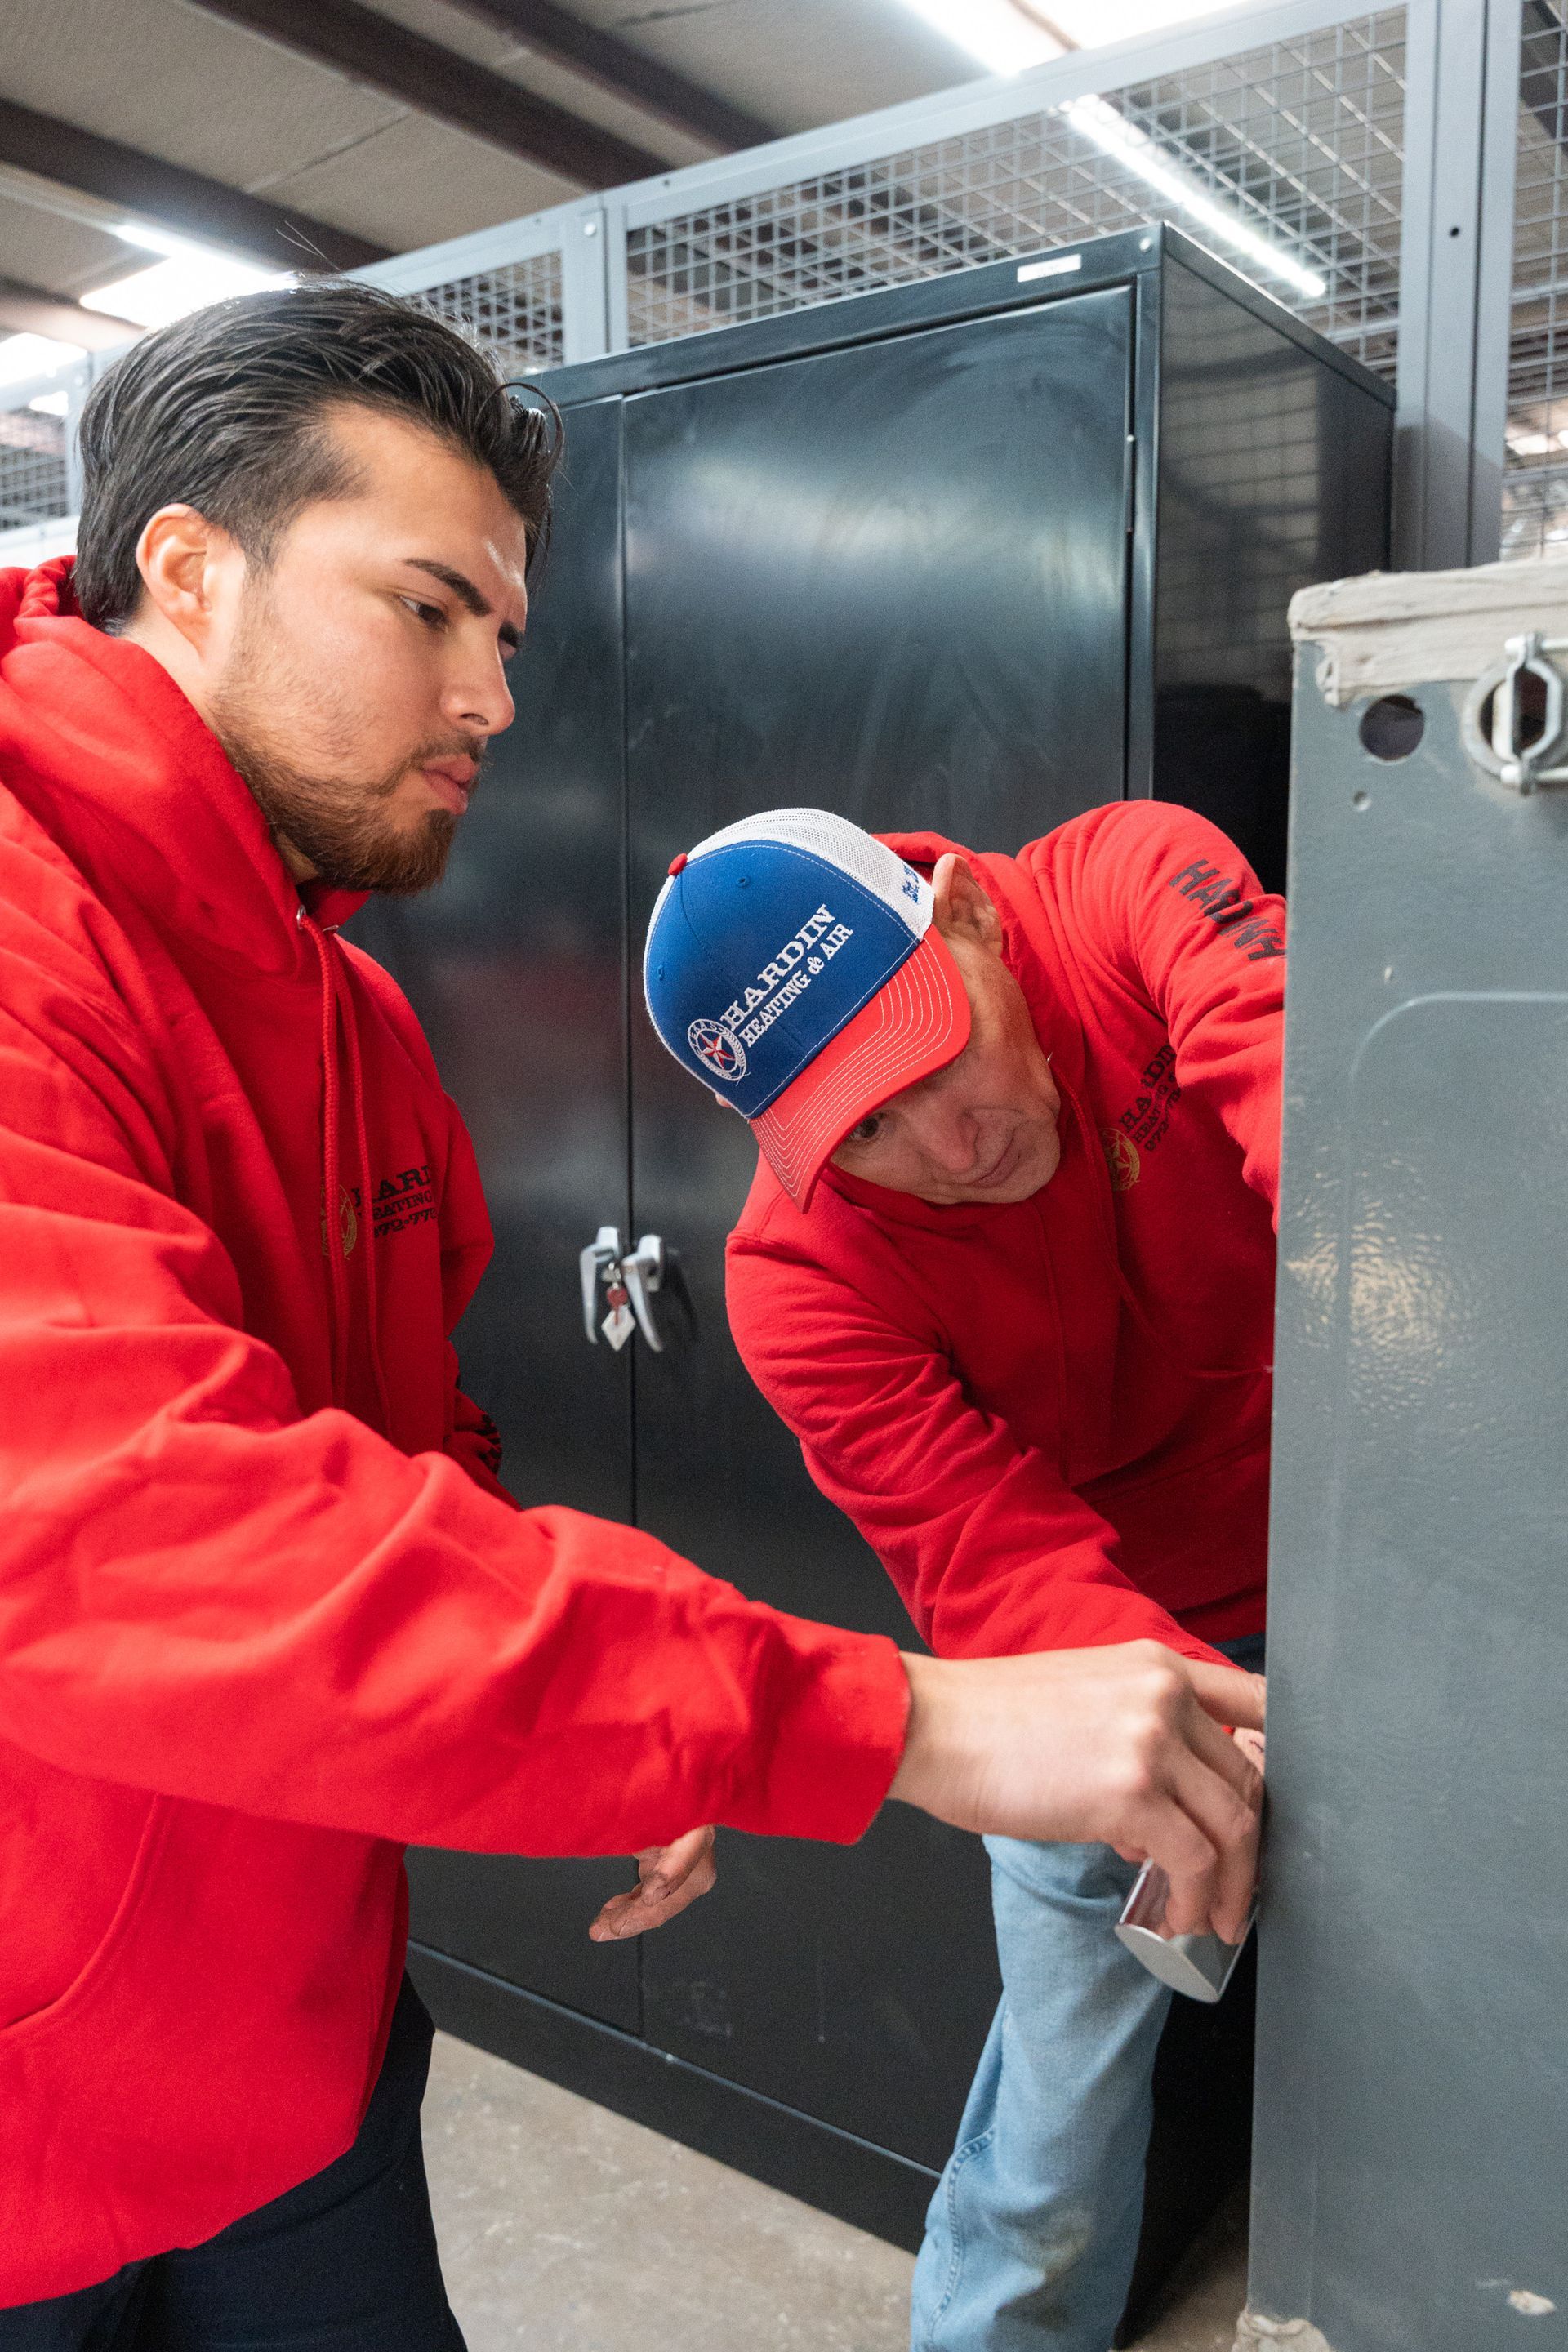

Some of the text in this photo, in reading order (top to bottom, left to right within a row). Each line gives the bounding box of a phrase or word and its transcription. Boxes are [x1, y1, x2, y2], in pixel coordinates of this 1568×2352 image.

[720, 903, 835, 1031] HARDIN
[738, 924, 853, 1047] HEATING & AIR
